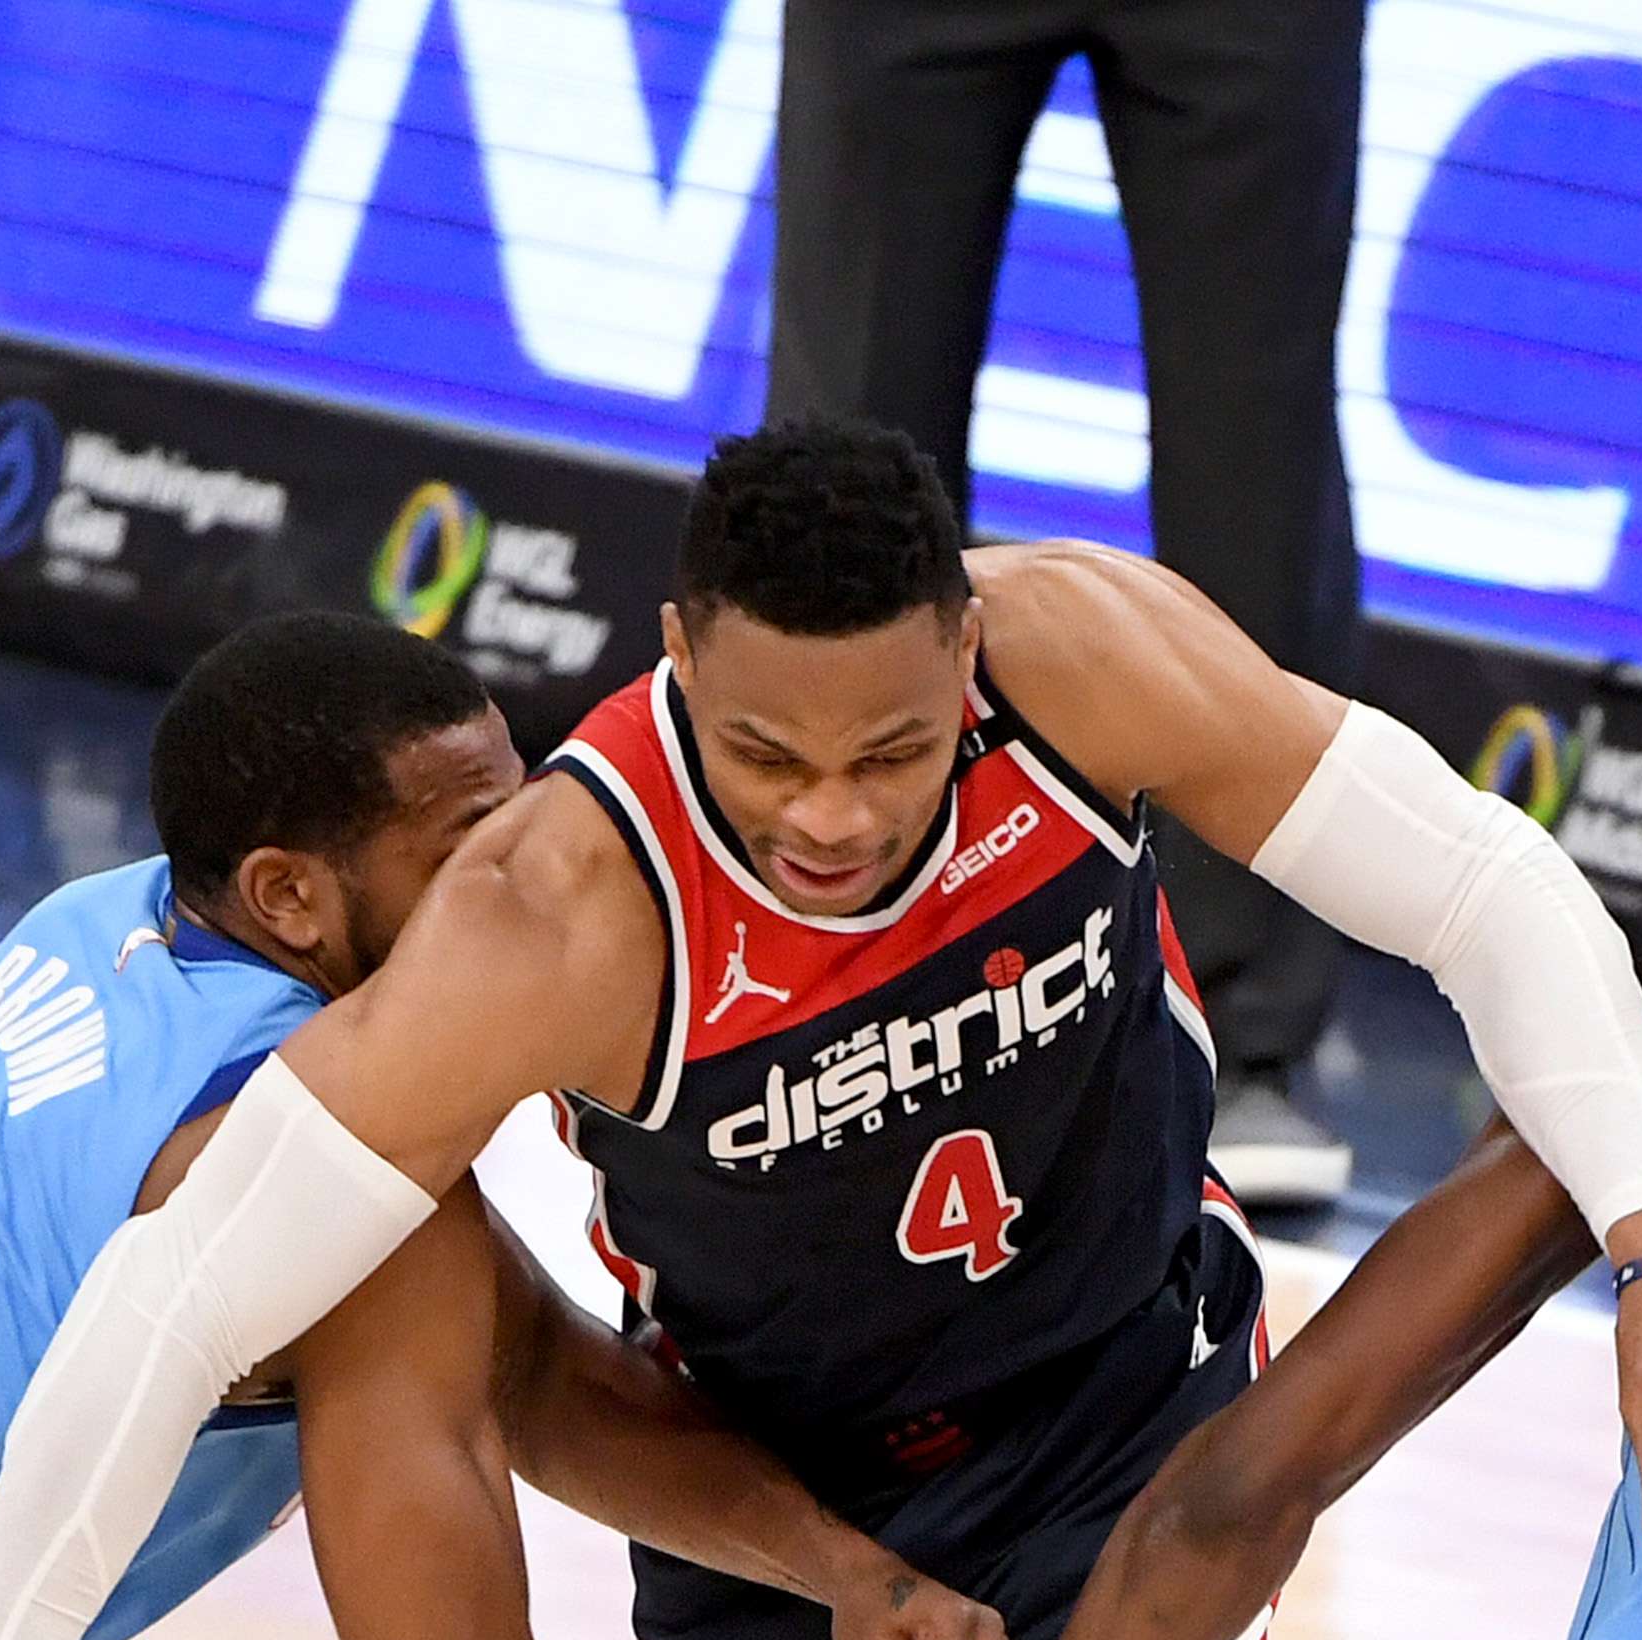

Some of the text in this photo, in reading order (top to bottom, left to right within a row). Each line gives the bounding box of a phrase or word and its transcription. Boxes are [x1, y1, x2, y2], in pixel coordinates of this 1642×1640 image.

[43, 487, 130, 562] Gas
[61, 428, 288, 536] Washington
[486, 520, 580, 600] WGL
[462, 577, 612, 676] Energy
[940, 803, 1041, 895] GEICO
[707, 905, 1114, 1161] district
[811, 1021, 881, 1069] THE
[895, 1128, 1023, 1282] 4
